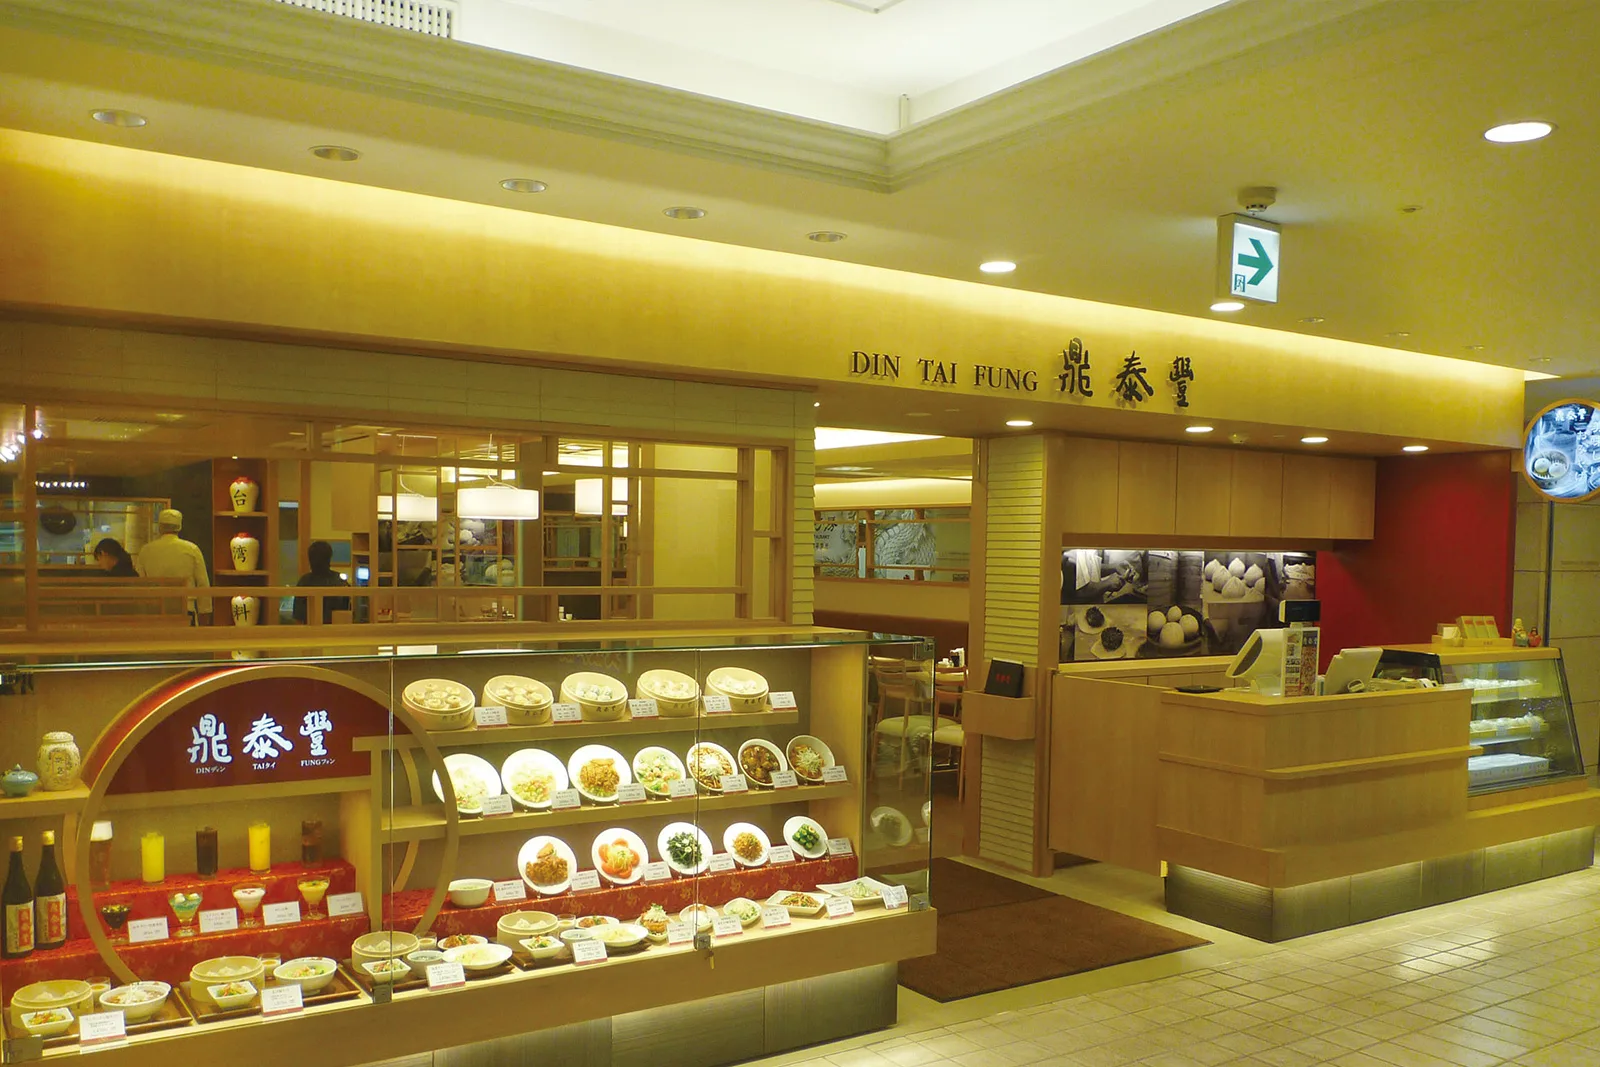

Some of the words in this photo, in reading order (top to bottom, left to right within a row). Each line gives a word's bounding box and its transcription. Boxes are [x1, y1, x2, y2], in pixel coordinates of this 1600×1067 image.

[852, 351, 902, 379] DIN
[918, 358, 957, 385] TAI
[974, 364, 1038, 392] FUNG
[233, 489, 247, 507] 台
[232, 604, 250, 622] 料
